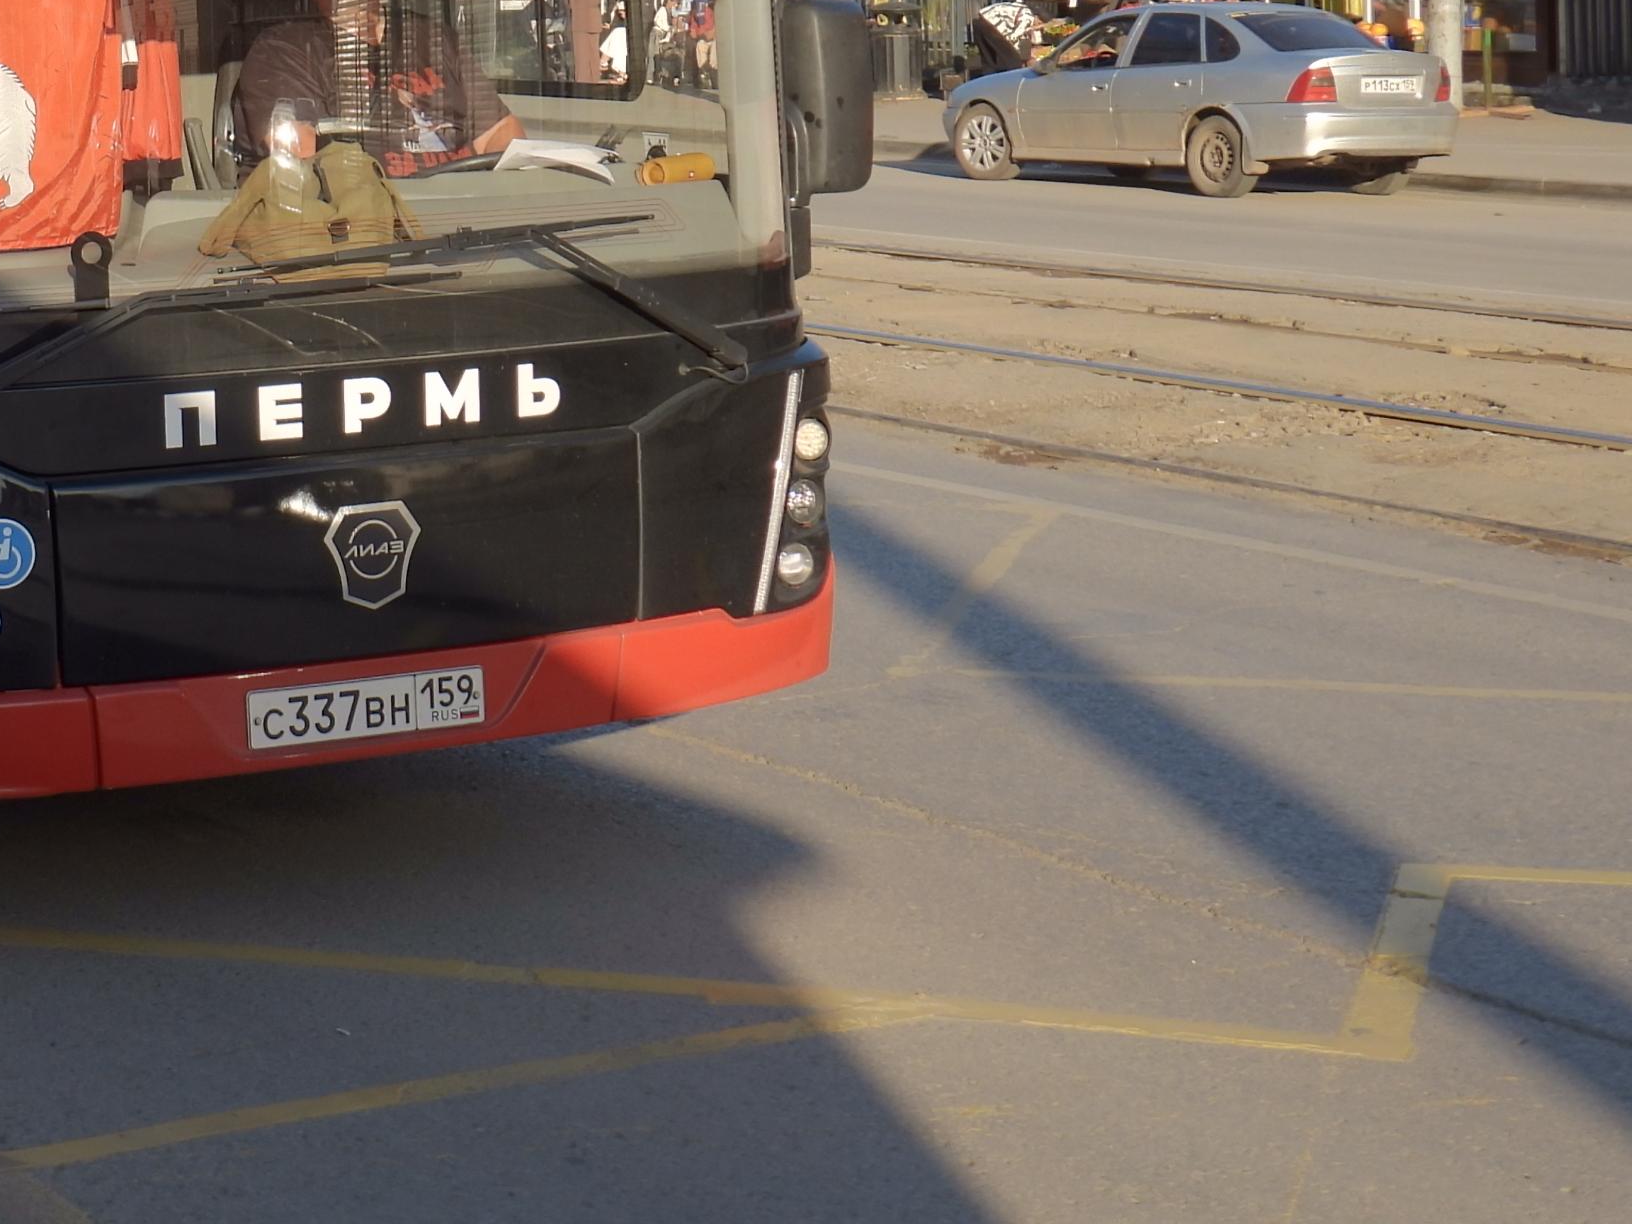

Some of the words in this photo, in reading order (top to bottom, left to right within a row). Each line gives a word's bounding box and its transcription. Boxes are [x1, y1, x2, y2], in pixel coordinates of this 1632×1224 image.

[164, 363, 561, 449] ПЕРМЬ
[263, 690, 410, 740] С337ВН
[421, 674, 473, 709] 159
[431, 708, 459, 723] RUS
